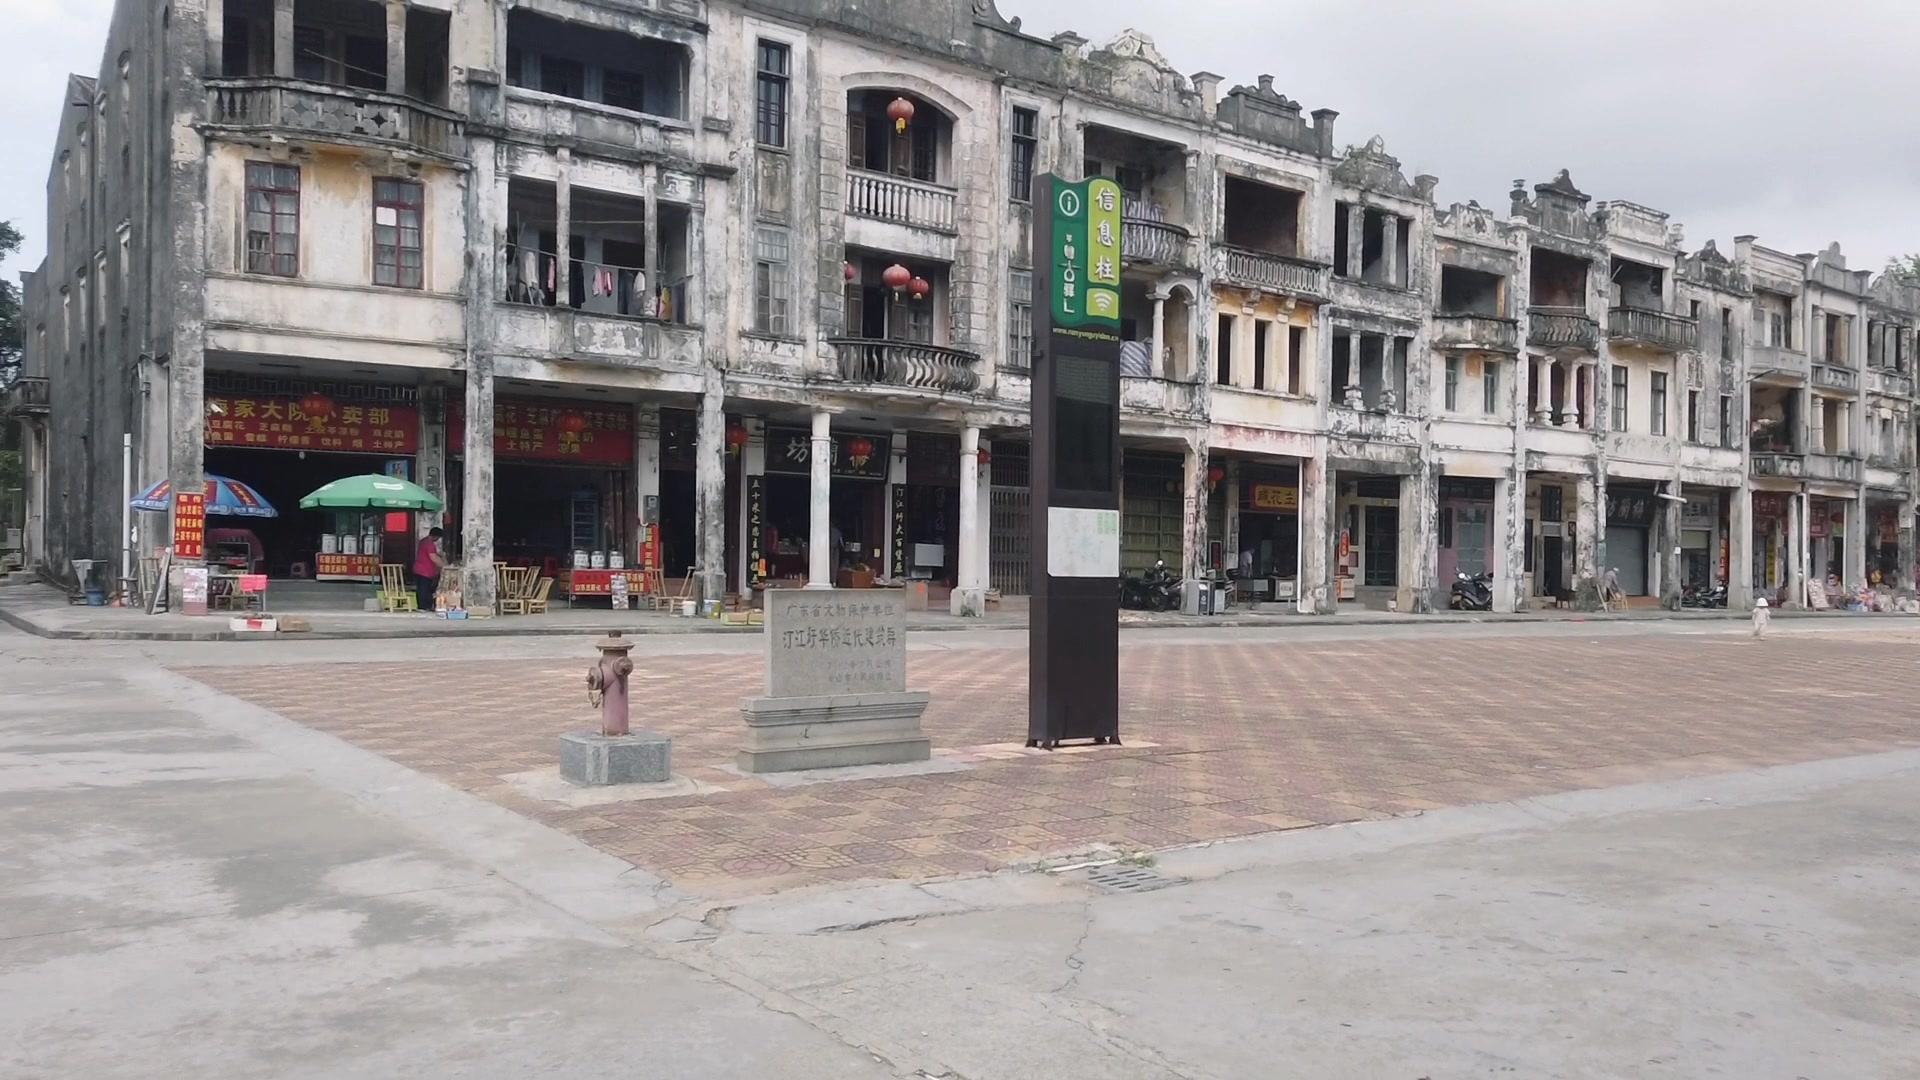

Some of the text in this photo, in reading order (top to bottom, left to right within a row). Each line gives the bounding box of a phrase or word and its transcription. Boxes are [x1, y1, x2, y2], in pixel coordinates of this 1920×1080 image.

[1096, 187, 1116, 281] 信息柱
[373, 441, 404, 450] 土特产
[507, 440, 543, 451] 土特产
[787, 603, 895, 619] 广东省文物保护单位
